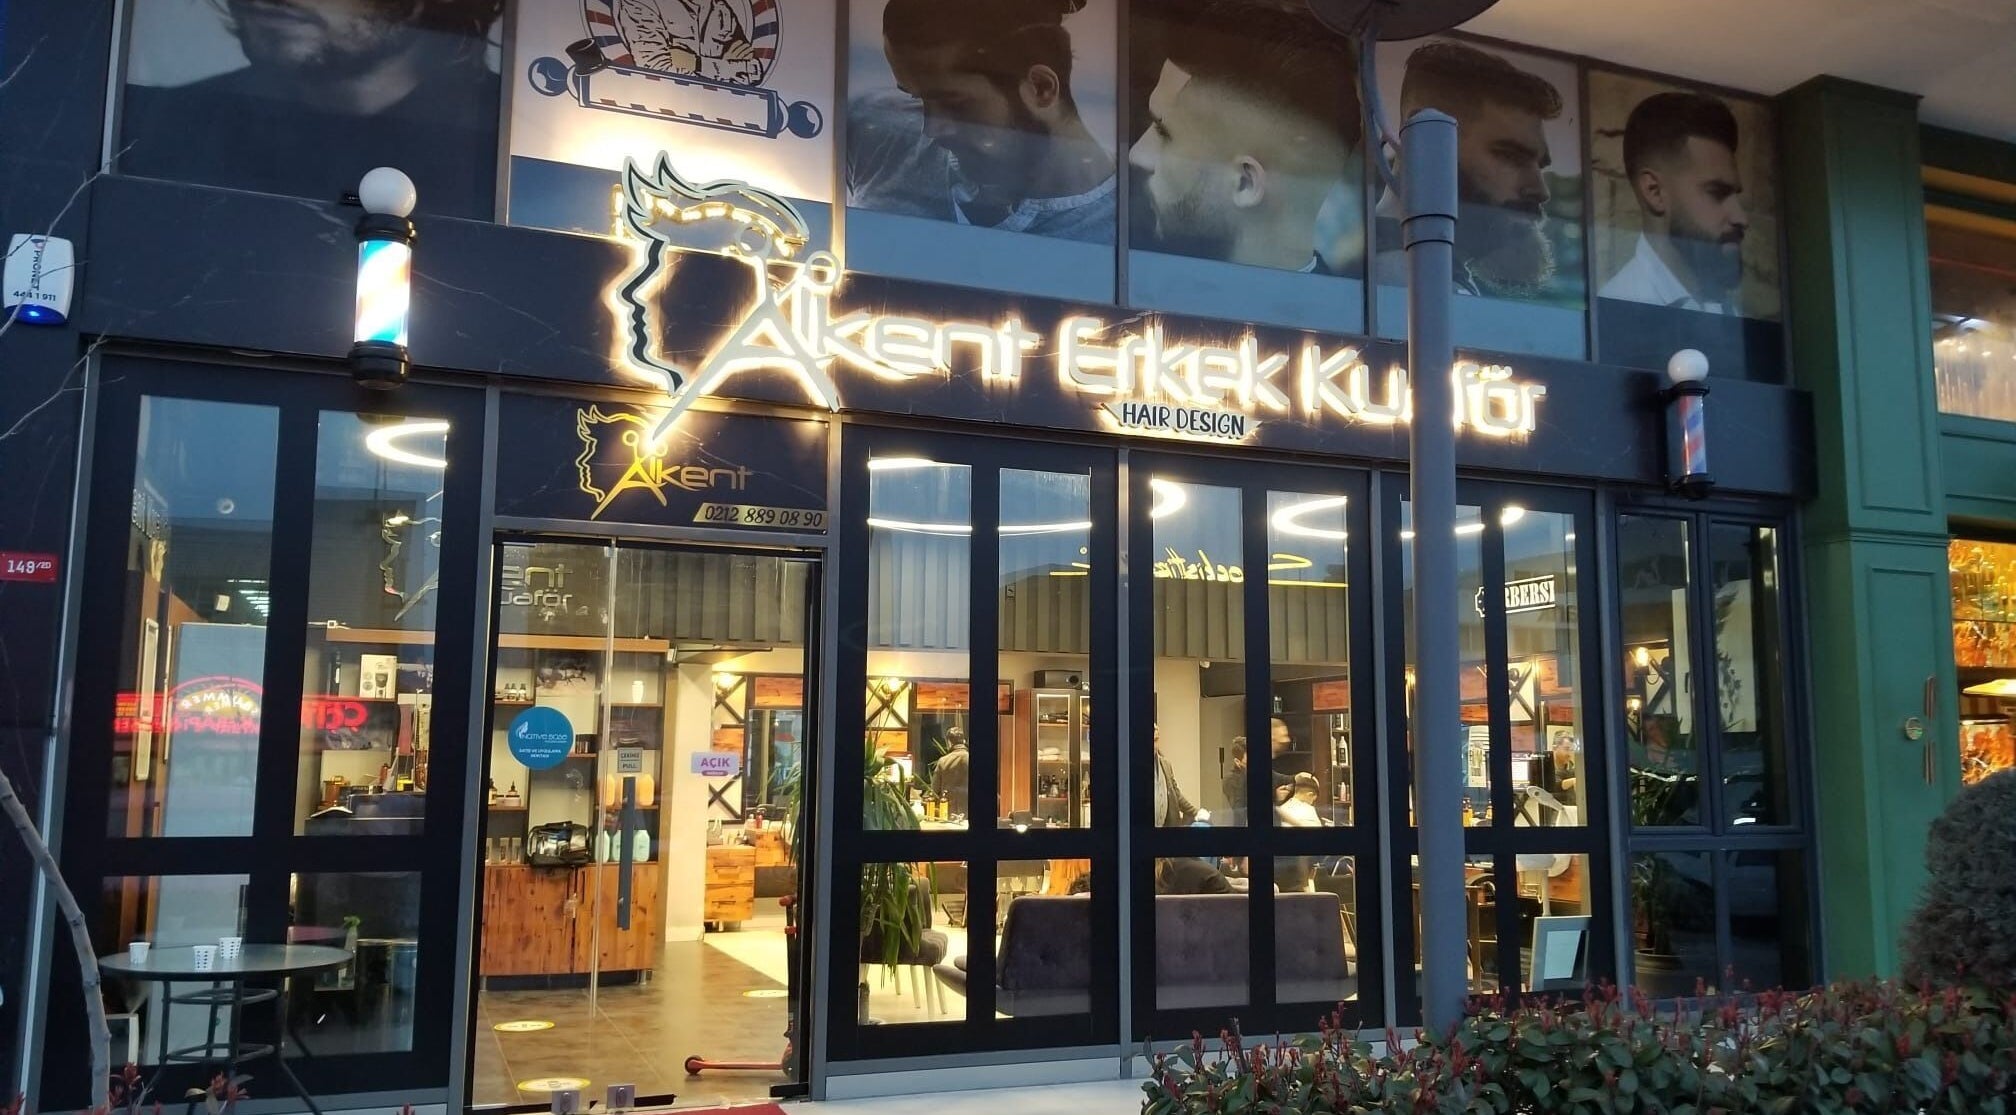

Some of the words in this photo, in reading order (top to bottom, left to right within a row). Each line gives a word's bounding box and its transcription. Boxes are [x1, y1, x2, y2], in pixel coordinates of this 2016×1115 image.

[653, 245, 1042, 440] Alkent
[1069, 315, 1290, 408] Erkek
[1311, 344, 1547, 431] Kuför
[1122, 402, 1171, 428] HAIR
[1176, 408, 1245, 436] DESIGN
[591, 442, 754, 521] Alkent
[704, 505, 739, 522] 0212
[744, 508, 776, 524] 889
[779, 511, 800, 526] 08
[804, 512, 823, 527] 90
[502, 564, 573, 589] ent
[701, 757, 730, 768] AÇIK
